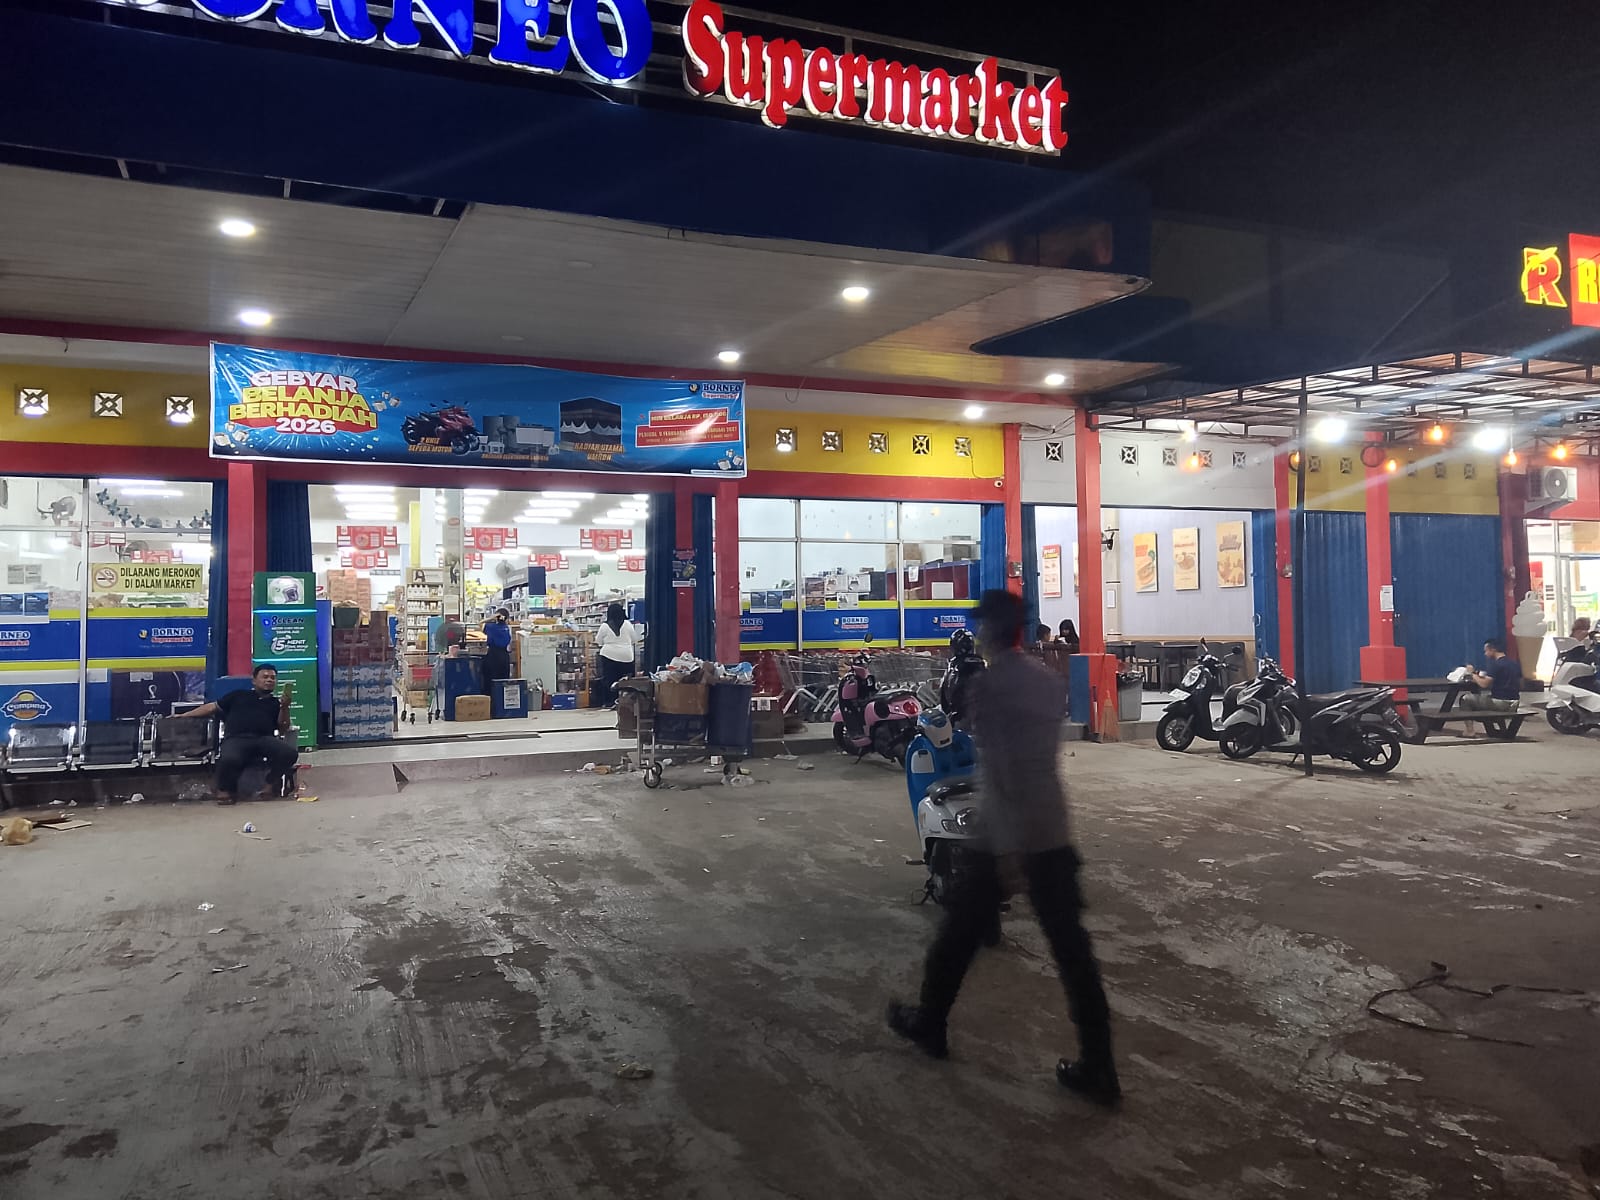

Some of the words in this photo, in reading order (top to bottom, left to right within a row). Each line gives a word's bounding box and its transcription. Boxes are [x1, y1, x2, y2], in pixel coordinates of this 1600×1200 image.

[682, 0, 1069, 152] Supermarket
[250, 370, 358, 393] GEBYAR
[702, 382, 741, 393] BORNEO
[242, 386, 371, 411] BELANJA
[229, 402, 378, 428] BERHADIAH
[276, 417, 337, 435] 2026
[120, 567, 160, 577] DILARANG
[162, 567, 201, 578] MEROKOK
[125, 579, 133, 588] DI
[135, 579, 162, 589] DALAM
[164, 579, 196, 589] MARKET
[151, 627, 195, 637] BORNEO
